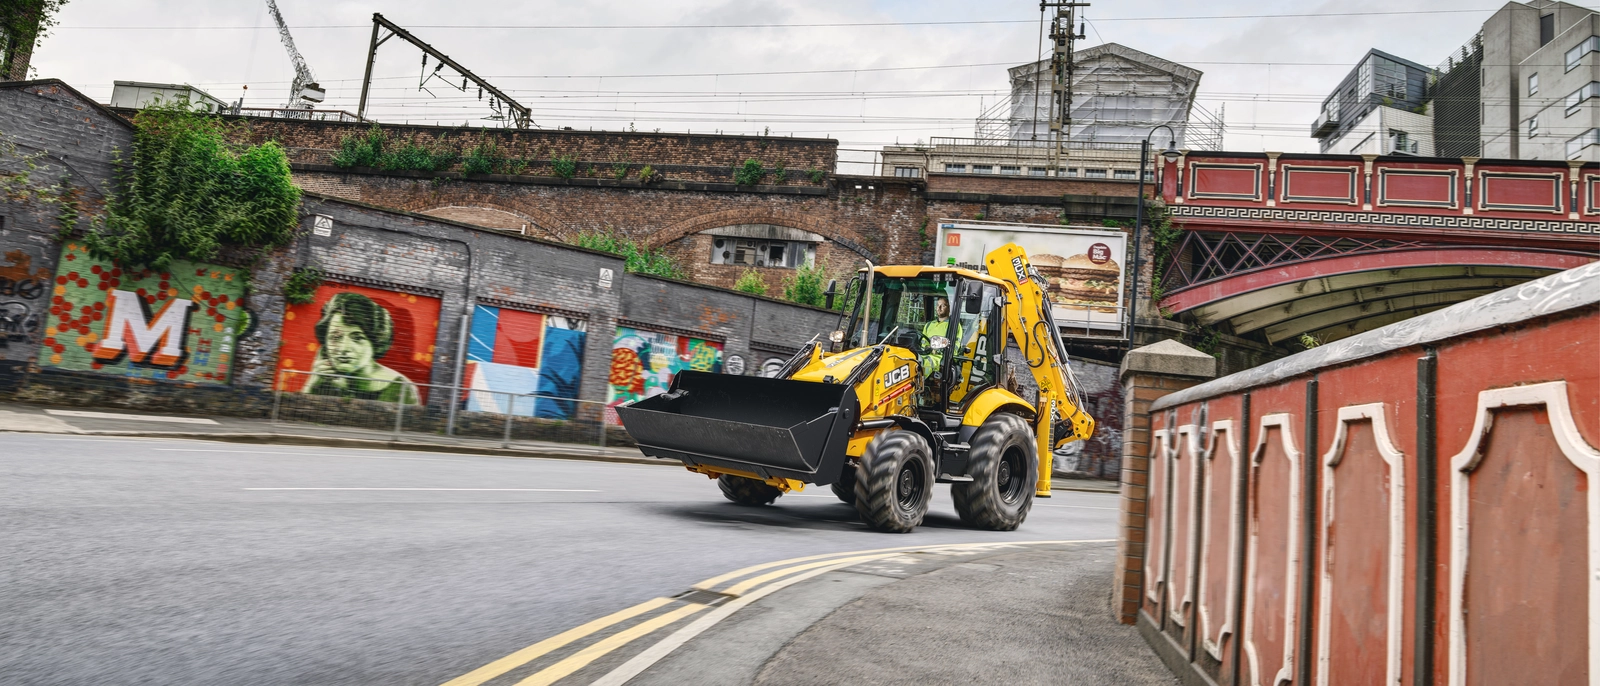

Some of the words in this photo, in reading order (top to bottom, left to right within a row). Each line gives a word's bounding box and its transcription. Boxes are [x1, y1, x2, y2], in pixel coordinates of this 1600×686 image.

[1012, 257, 1026, 280] 3CX
[97, 289, 194, 363] M
[885, 365, 910, 388] JCB
